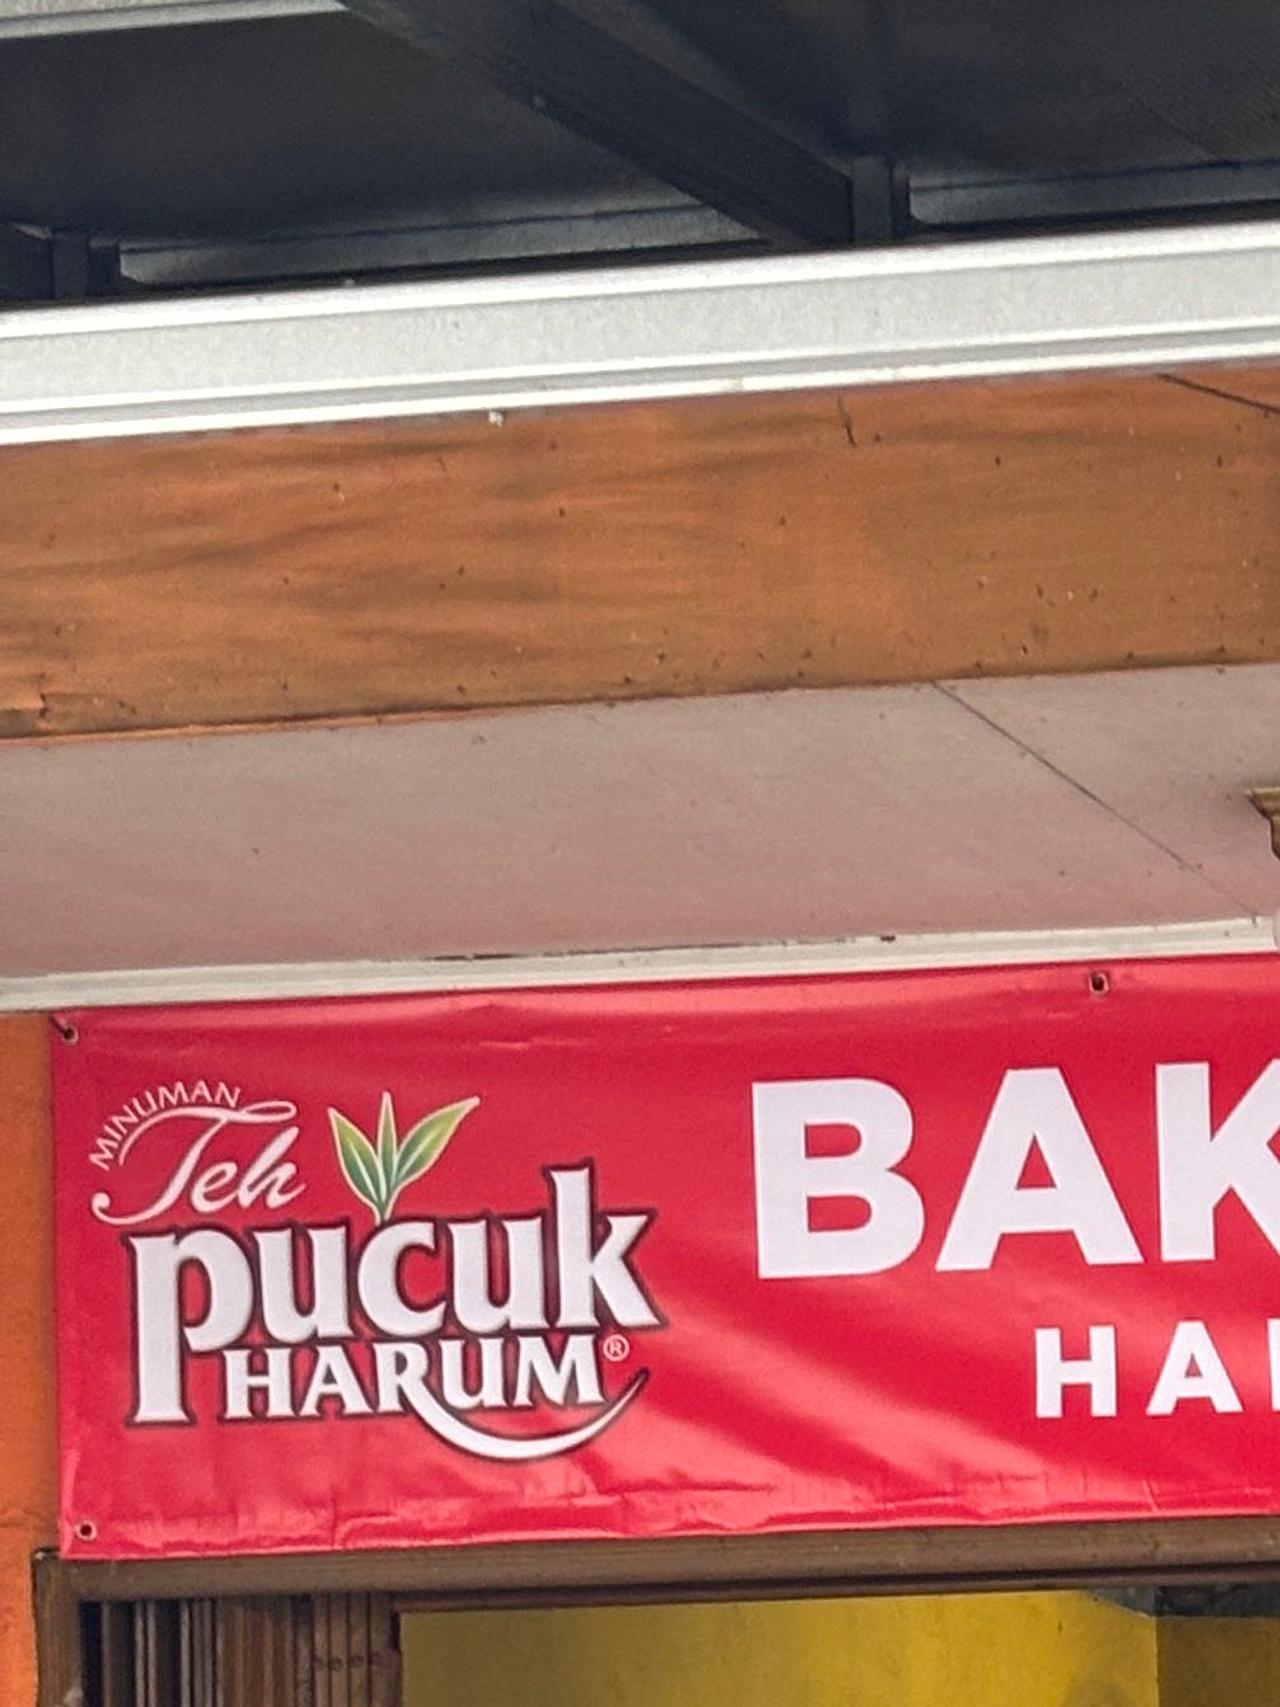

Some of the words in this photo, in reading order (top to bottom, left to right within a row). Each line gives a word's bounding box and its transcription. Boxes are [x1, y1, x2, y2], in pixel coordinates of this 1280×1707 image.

[89, 1079, 241, 1171] MINUMAN
[91, 1101, 307, 1225] Teh
[130, 1160, 663, 1421] pucuk
[222, 1337, 620, 1440] HARUM
